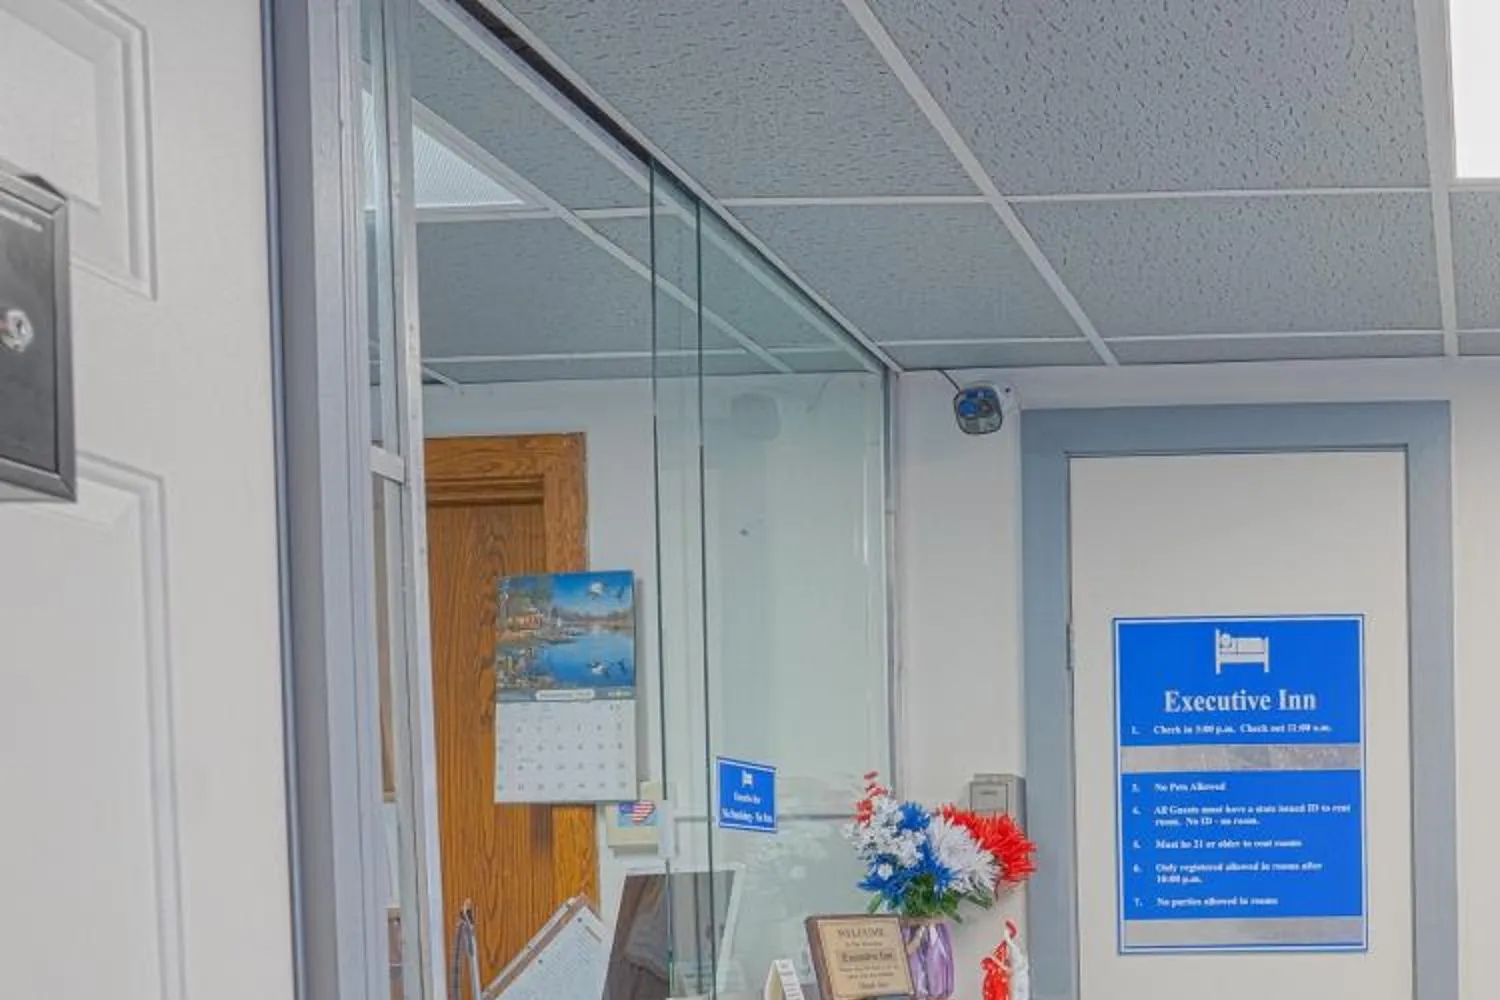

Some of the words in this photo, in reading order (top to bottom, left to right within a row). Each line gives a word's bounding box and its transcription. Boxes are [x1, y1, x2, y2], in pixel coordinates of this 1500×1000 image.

[1164, 689, 1272, 713] Executive
[1278, 688, 1317, 711] Inn
[1153, 724, 1181, 735] Check
[1183, 724, 1193, 734] in
[1240, 722, 1269, 733] Check
[1270, 723, 1285, 733] out
[1154, 782, 1167, 792] No
[1169, 782, 1189, 792] Pets
[1190, 781, 1227, 792] Allowed
[1154, 805, 1168, 815] All
[1169, 805, 1200, 815] Guests
[1225, 803, 1246, 814] have
[1307, 803, 1320, 813] ID
[1321, 803, 1331, 812] to
[1332, 803, 1351, 812] rent
[1186, 816, 1199, 826] No
[1201, 816, 1213, 825] ID
[1155, 839, 1179, 849] Must
[1194, 839, 1204, 849] 21
[1205, 840, 1216, 849] or
[1217, 838, 1241, 848] older
[1243, 839, 1252, 848] to
[1253, 839, 1273, 848] rent
[1155, 863, 1178, 873] Only
[1180, 862, 1223, 873] registered
[1301, 861, 1323, 870] after
[1156, 897, 1170, 906] No
[1171, 896, 1202, 908] parties
